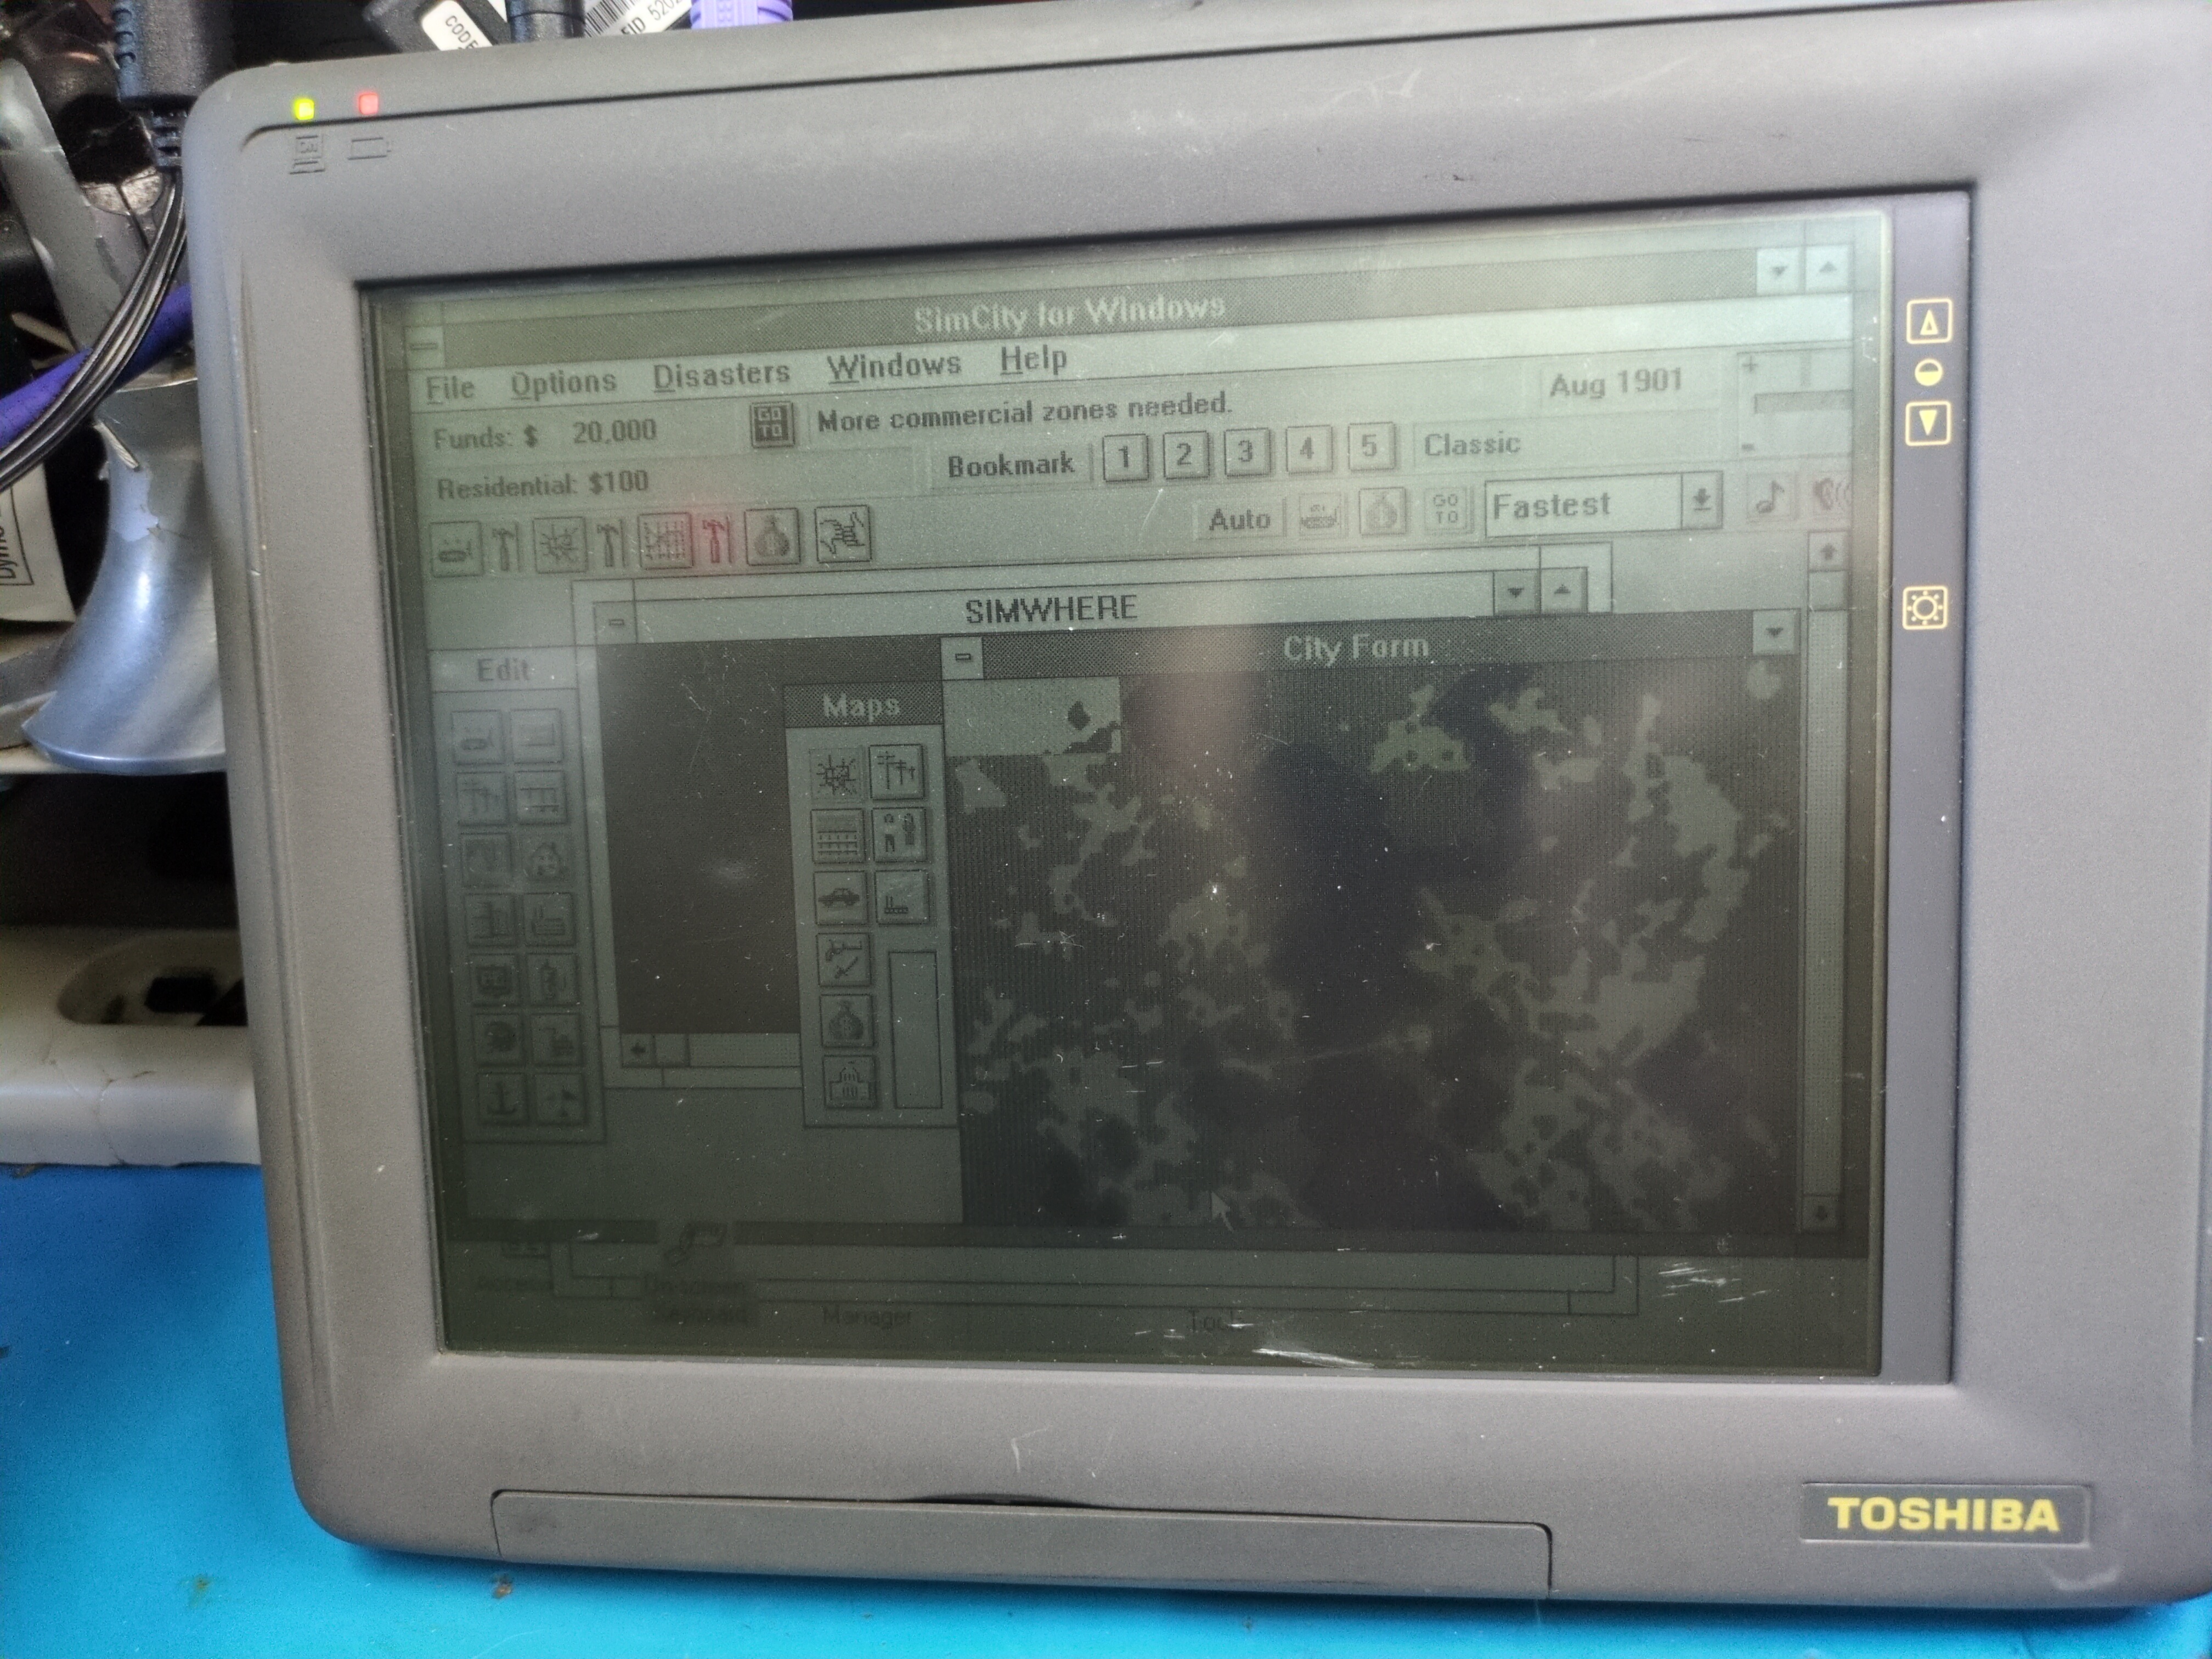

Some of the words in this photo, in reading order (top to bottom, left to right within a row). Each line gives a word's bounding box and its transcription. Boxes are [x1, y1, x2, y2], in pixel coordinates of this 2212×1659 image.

[647, 0, 683, 20] 520
[915, 304, 1026, 335] SimCity
[1039, 302, 1075, 328] for
[1085, 295, 1225, 324] Windows
[426, 376, 475, 404] File
[511, 370, 616, 401] Options
[653, 363, 790, 392] Disasters
[827, 352, 961, 384] Windows
[1001, 345, 1067, 375] Help
[1549, 374, 1605, 399] Aug
[1619, 368, 1681, 393] 1901
[818, 410, 880, 432] More
[889, 399, 1034, 428] commercial
[1043, 401, 1118, 421] zones
[1128, 391, 1232, 417] needed.
[434, 427, 512, 449] Funds:
[523, 425, 538, 448] $
[1300, 436, 1313, 459] 4
[1362, 434, 1376, 456] 5
[1425, 431, 1521, 456] Classic
[1118, 445, 1130, 468] 1
[1177, 445, 1192, 465] 2
[1237, 439, 1253, 462] 3
[948, 452, 1075, 478] Bookmark
[438, 473, 577, 499] Residential:
[588, 470, 649, 494] $100
[1494, 492, 1610, 520] Fastest
[1210, 508, 1271, 531] Auto
[966, 595, 1138, 624] SIMWHERE
[1284, 634, 1342, 667] City
[1353, 634, 1427, 658] Form
[477, 658, 530, 681] Edit
[823, 692, 900, 723] Maps
[1827, 1497, 2060, 1532] TOSHIBA
